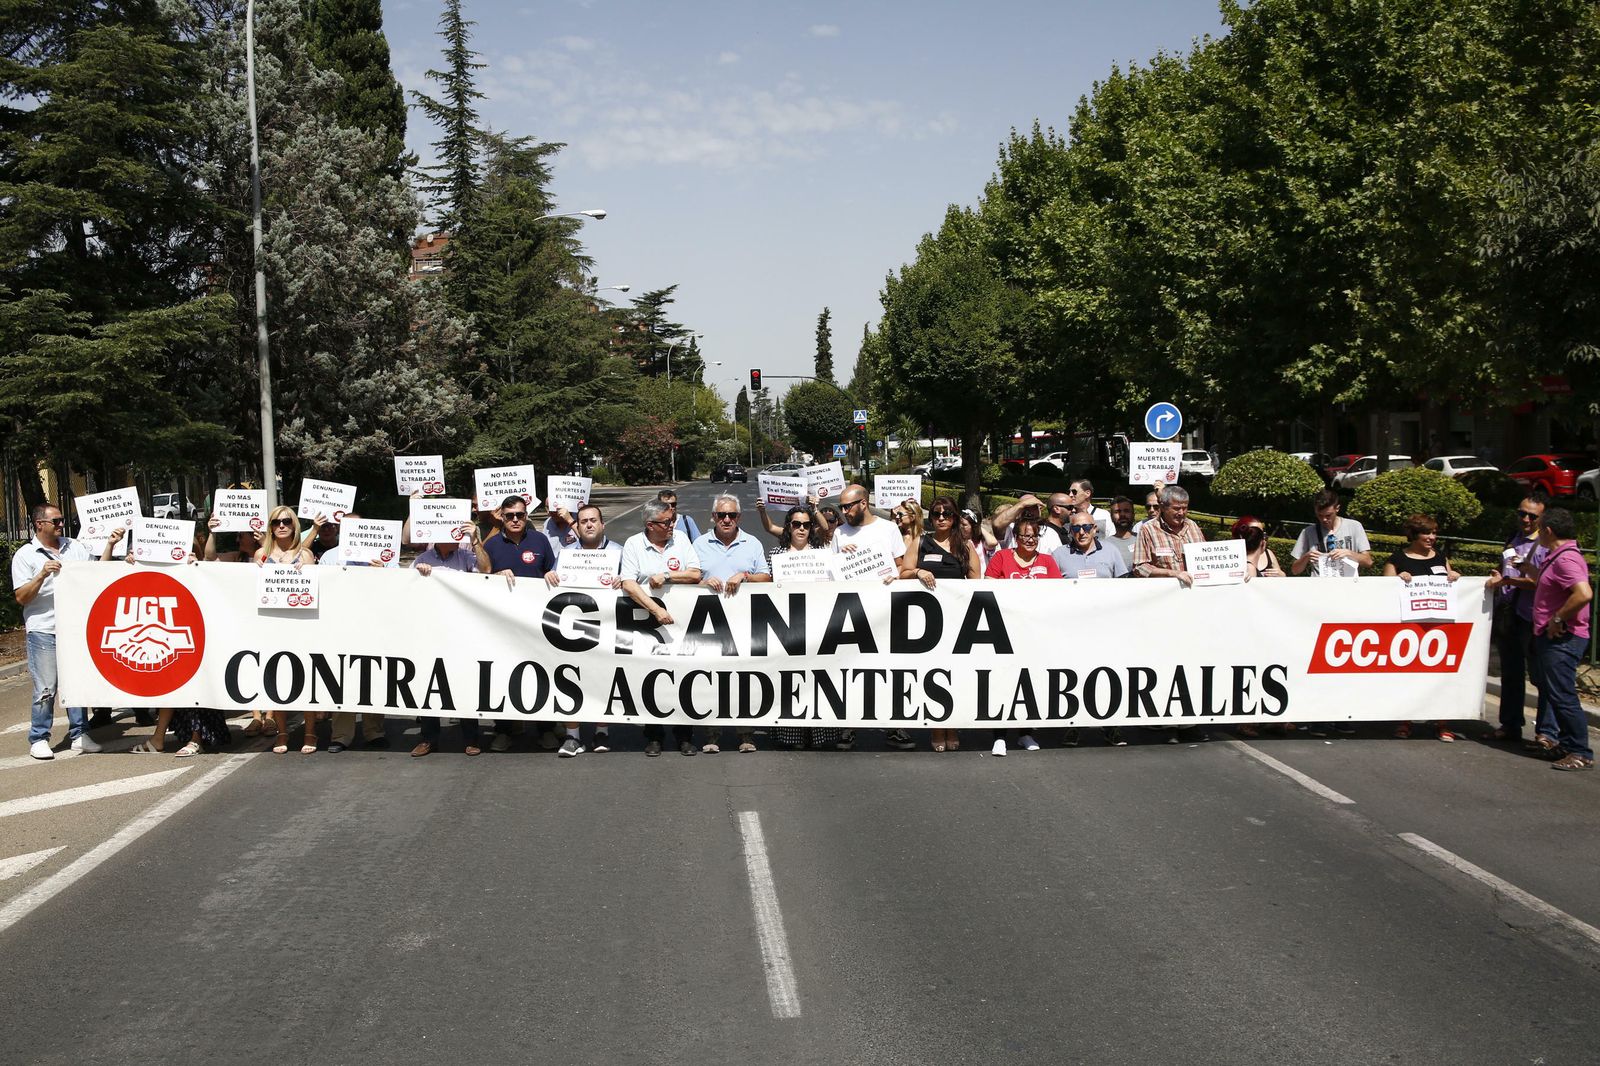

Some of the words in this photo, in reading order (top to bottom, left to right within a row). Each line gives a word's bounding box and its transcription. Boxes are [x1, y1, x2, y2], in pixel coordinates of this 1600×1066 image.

[313, 484, 343, 494] DENUNCIA
[87, 504, 121, 514] MUERTES
[304, 498, 348, 509] INCUMPLIMIENTO
[101, 510, 133, 520] TRABAJO
[857, 548, 872, 557] MAS
[841, 558, 872, 572] MUERTES
[854, 561, 885, 576] TRABAJO
[115, 596, 178, 627] UGT
[541, 592, 1013, 656] GRANADA
[1324, 629, 1457, 668] CC.OO.
[225, 650, 457, 711] CONTRA
[477, 660, 584, 716] LOS
[604, 666, 953, 722] ACCIDENTES
[974, 664, 1289, 721] LABORALES
